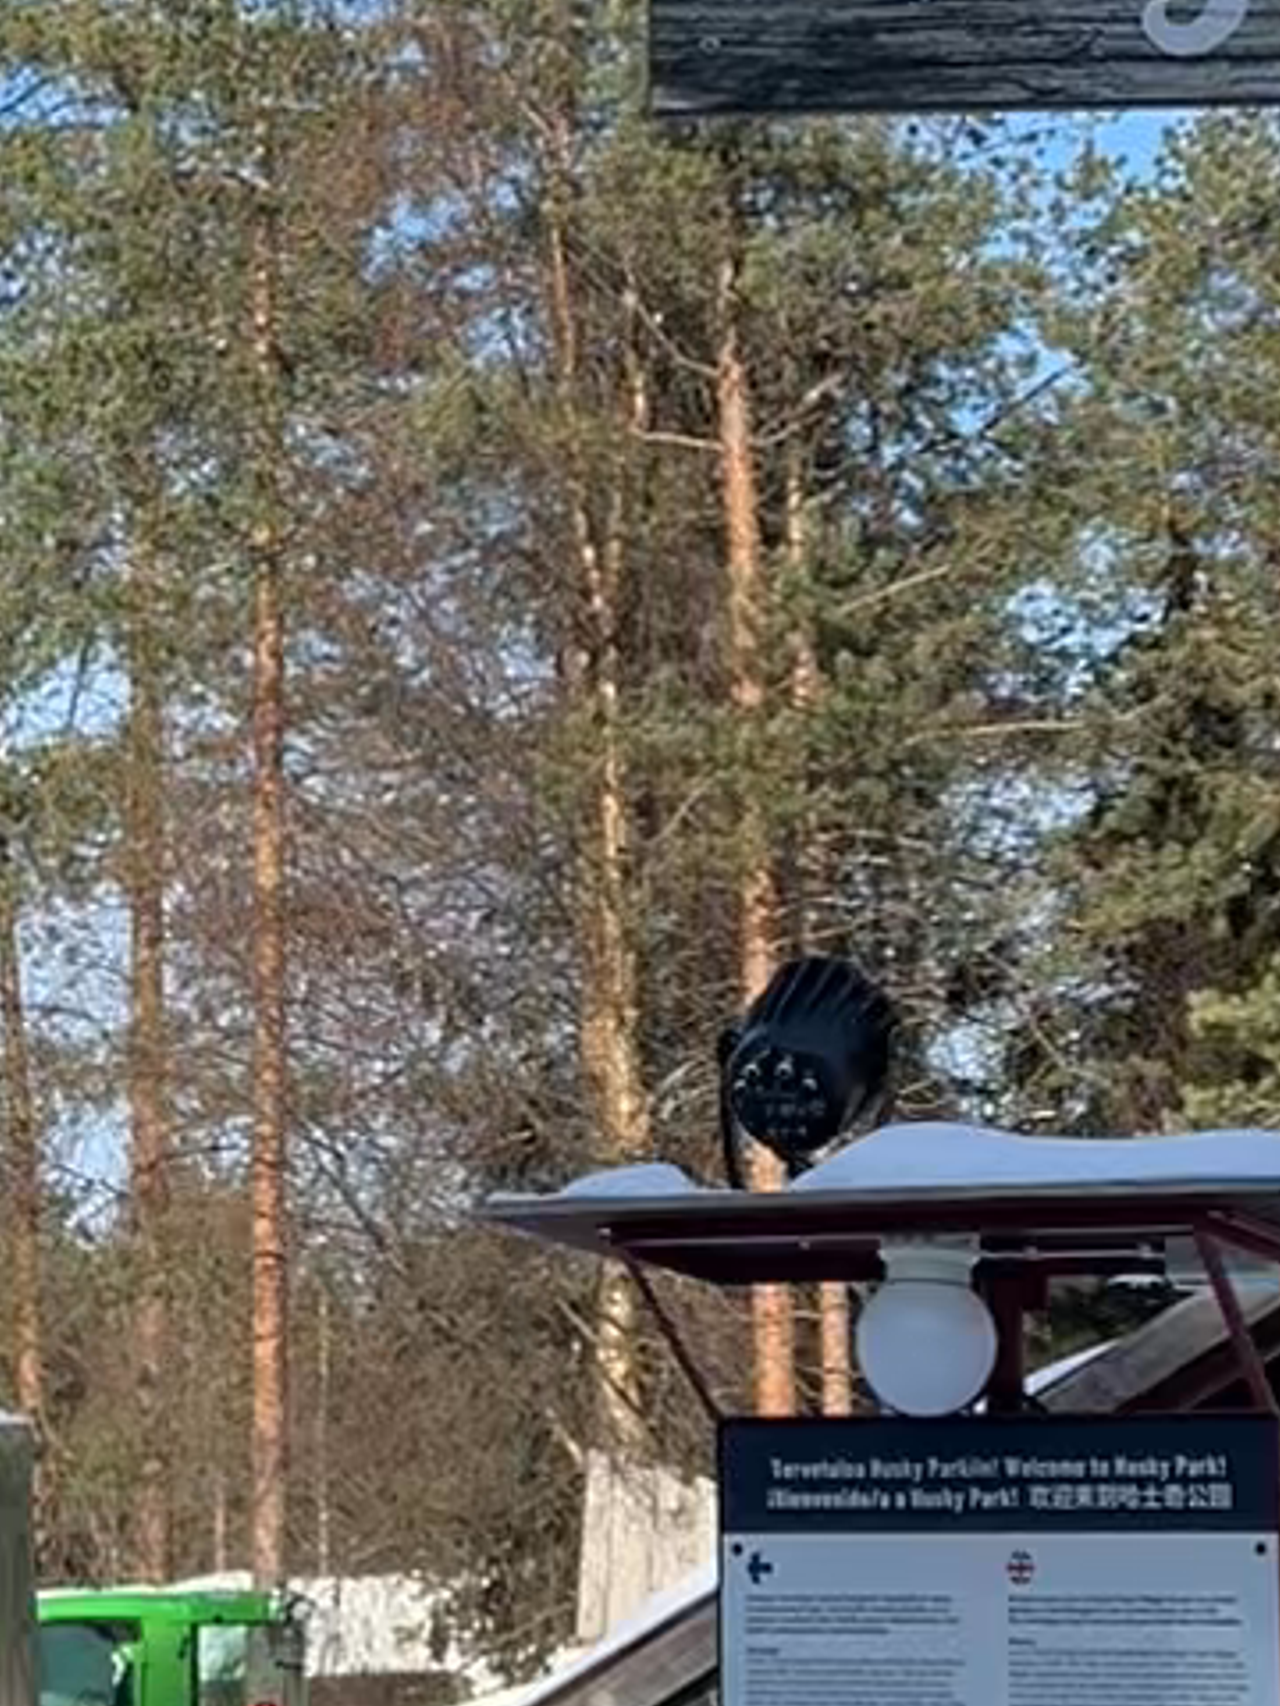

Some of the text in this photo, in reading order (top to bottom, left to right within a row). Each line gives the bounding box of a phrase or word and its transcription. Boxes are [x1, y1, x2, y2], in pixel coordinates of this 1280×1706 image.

[871, 1457, 923, 1483] Husky
[1004, 1456, 1085, 1478] Welcome
[1090, 1456, 1109, 1477] to
[1115, 1455, 1170, 1482] Husky
[1175, 1454, 1226, 1478] Park!
[911, 1487, 964, 1514] Husky
[969, 1486, 1019, 1508] Park!
